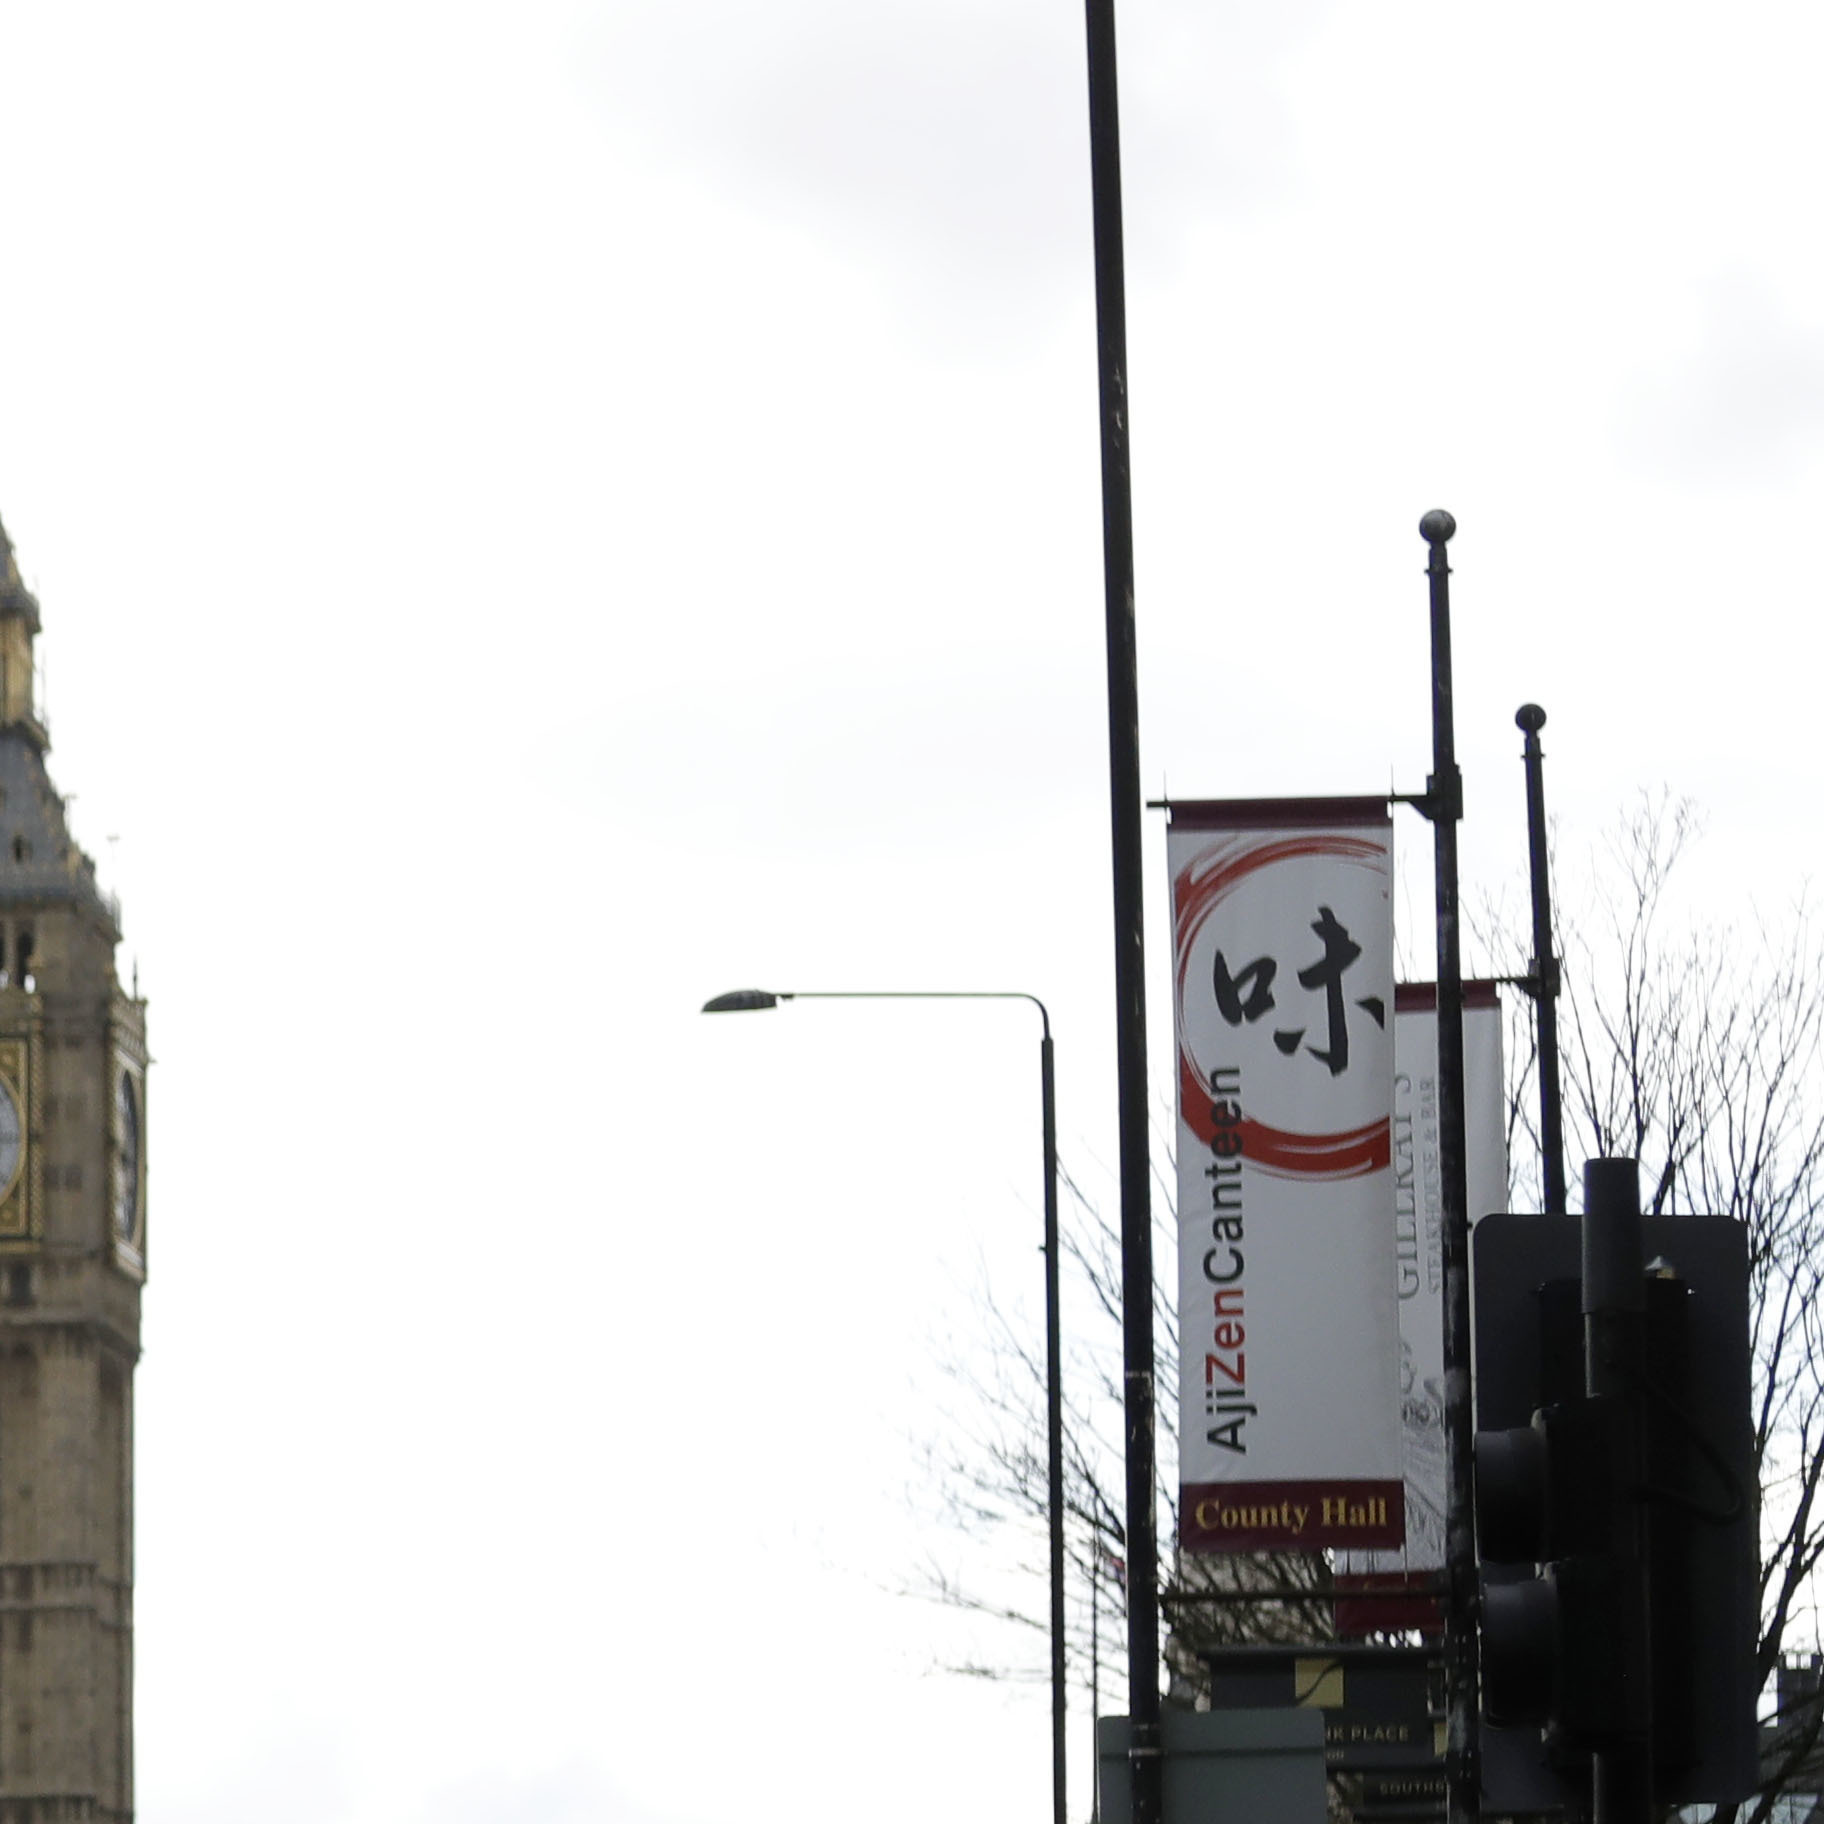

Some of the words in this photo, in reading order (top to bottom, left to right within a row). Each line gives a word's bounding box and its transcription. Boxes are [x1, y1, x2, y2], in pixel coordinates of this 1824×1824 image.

[1203, 1065, 1258, 1456] AjiZenCanteen
[1195, 1498, 1309, 1535] County
[1320, 1497, 1387, 1527] Hall
[1352, 1725, 1409, 1741] PLACE
